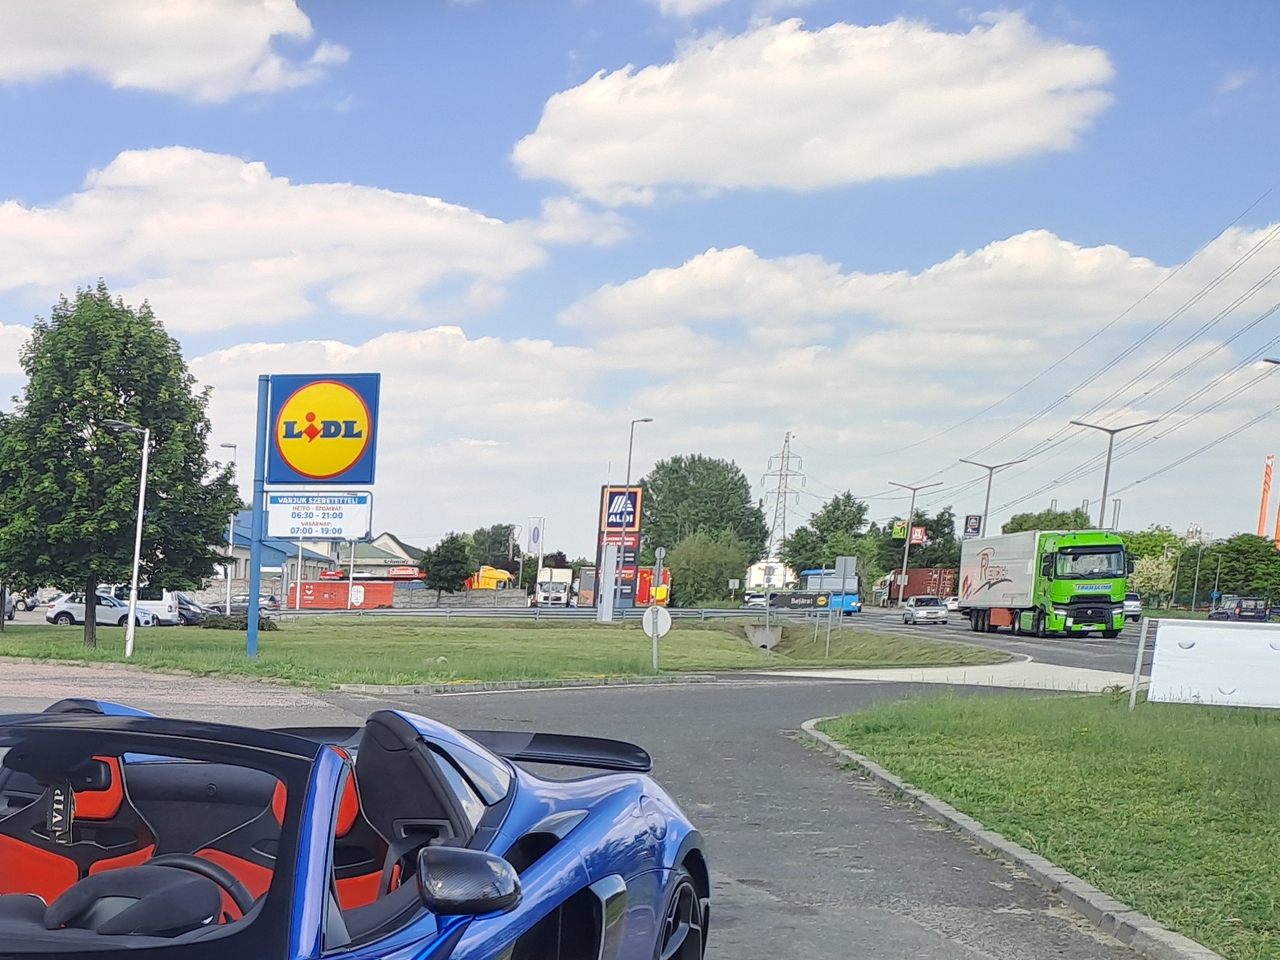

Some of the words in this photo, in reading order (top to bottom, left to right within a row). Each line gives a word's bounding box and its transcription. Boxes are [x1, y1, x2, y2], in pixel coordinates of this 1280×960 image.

[291, 511, 314, 519] 06:30
[608, 514, 634, 522] ALDI
[290, 527, 313, 535] 07:00
[321, 527, 343, 535] 19:00
